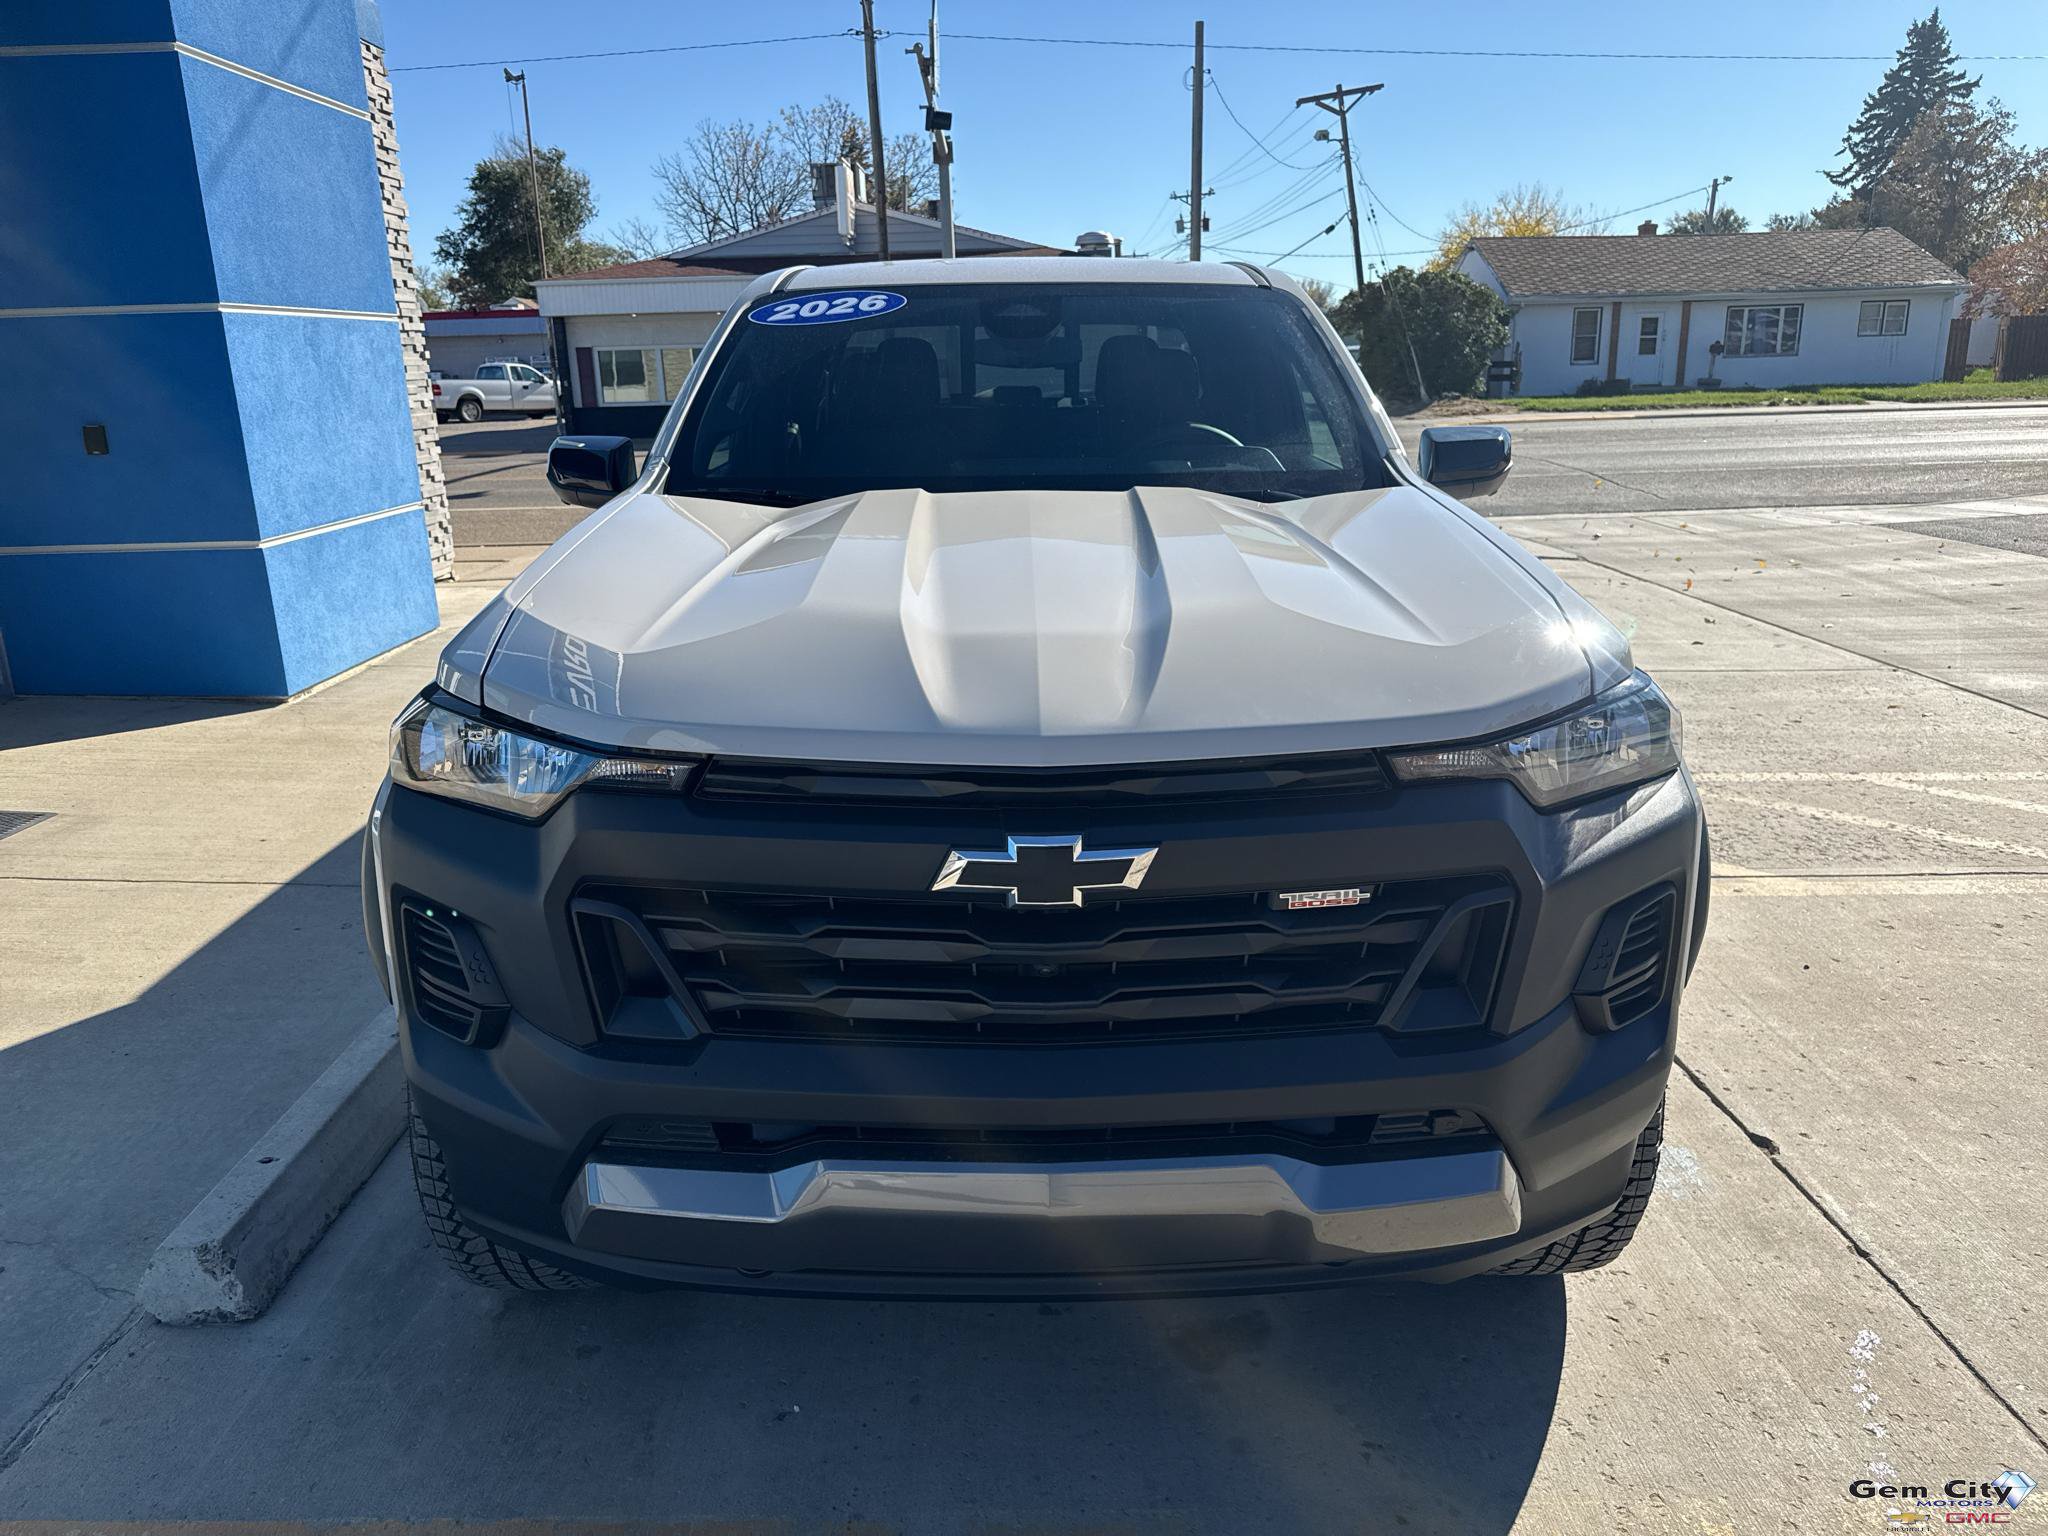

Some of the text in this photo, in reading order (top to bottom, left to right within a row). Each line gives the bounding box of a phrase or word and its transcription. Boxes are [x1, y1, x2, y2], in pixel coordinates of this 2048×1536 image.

[767, 294, 888, 322] 2026
[1280, 889, 1370, 902] TRAIL
[1289, 897, 1360, 909] BOSS
